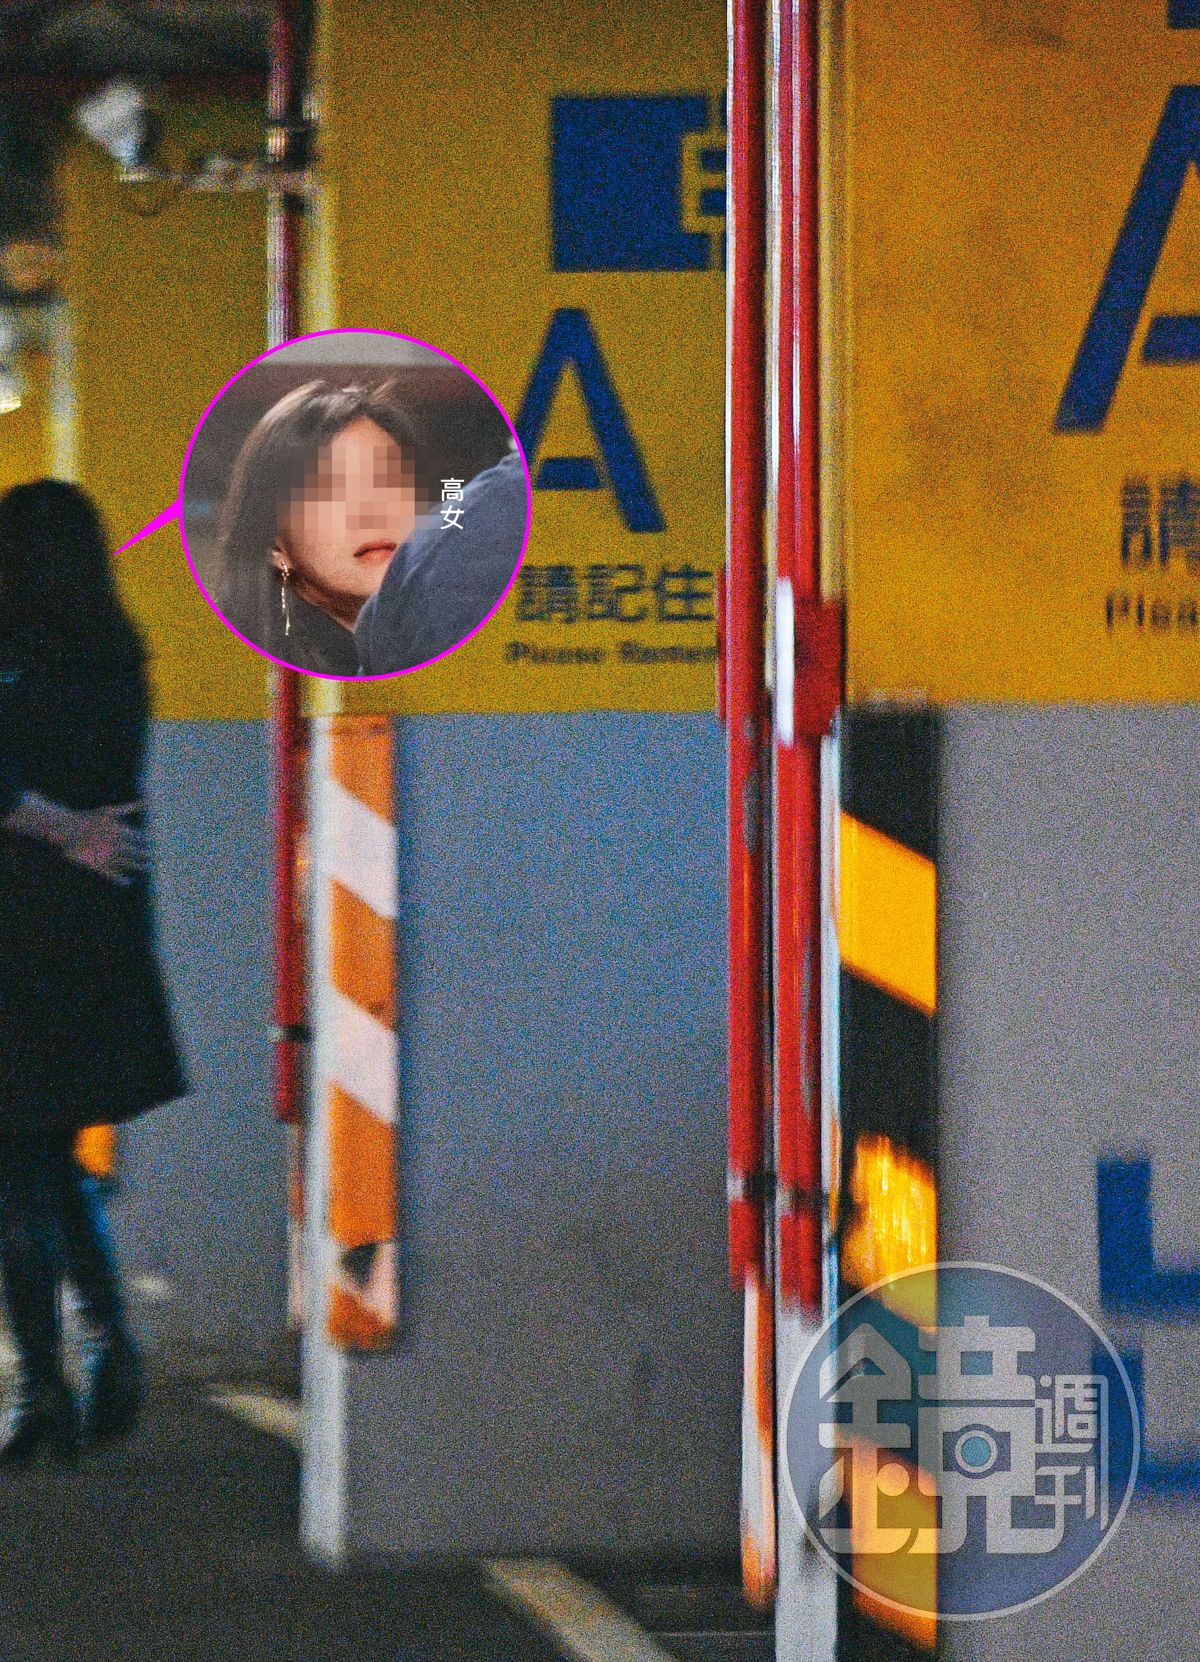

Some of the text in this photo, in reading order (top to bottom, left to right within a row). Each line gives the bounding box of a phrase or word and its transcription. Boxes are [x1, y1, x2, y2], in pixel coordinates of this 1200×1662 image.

[513, 307, 668, 533] A
[516, 563, 714, 624] 請記住
